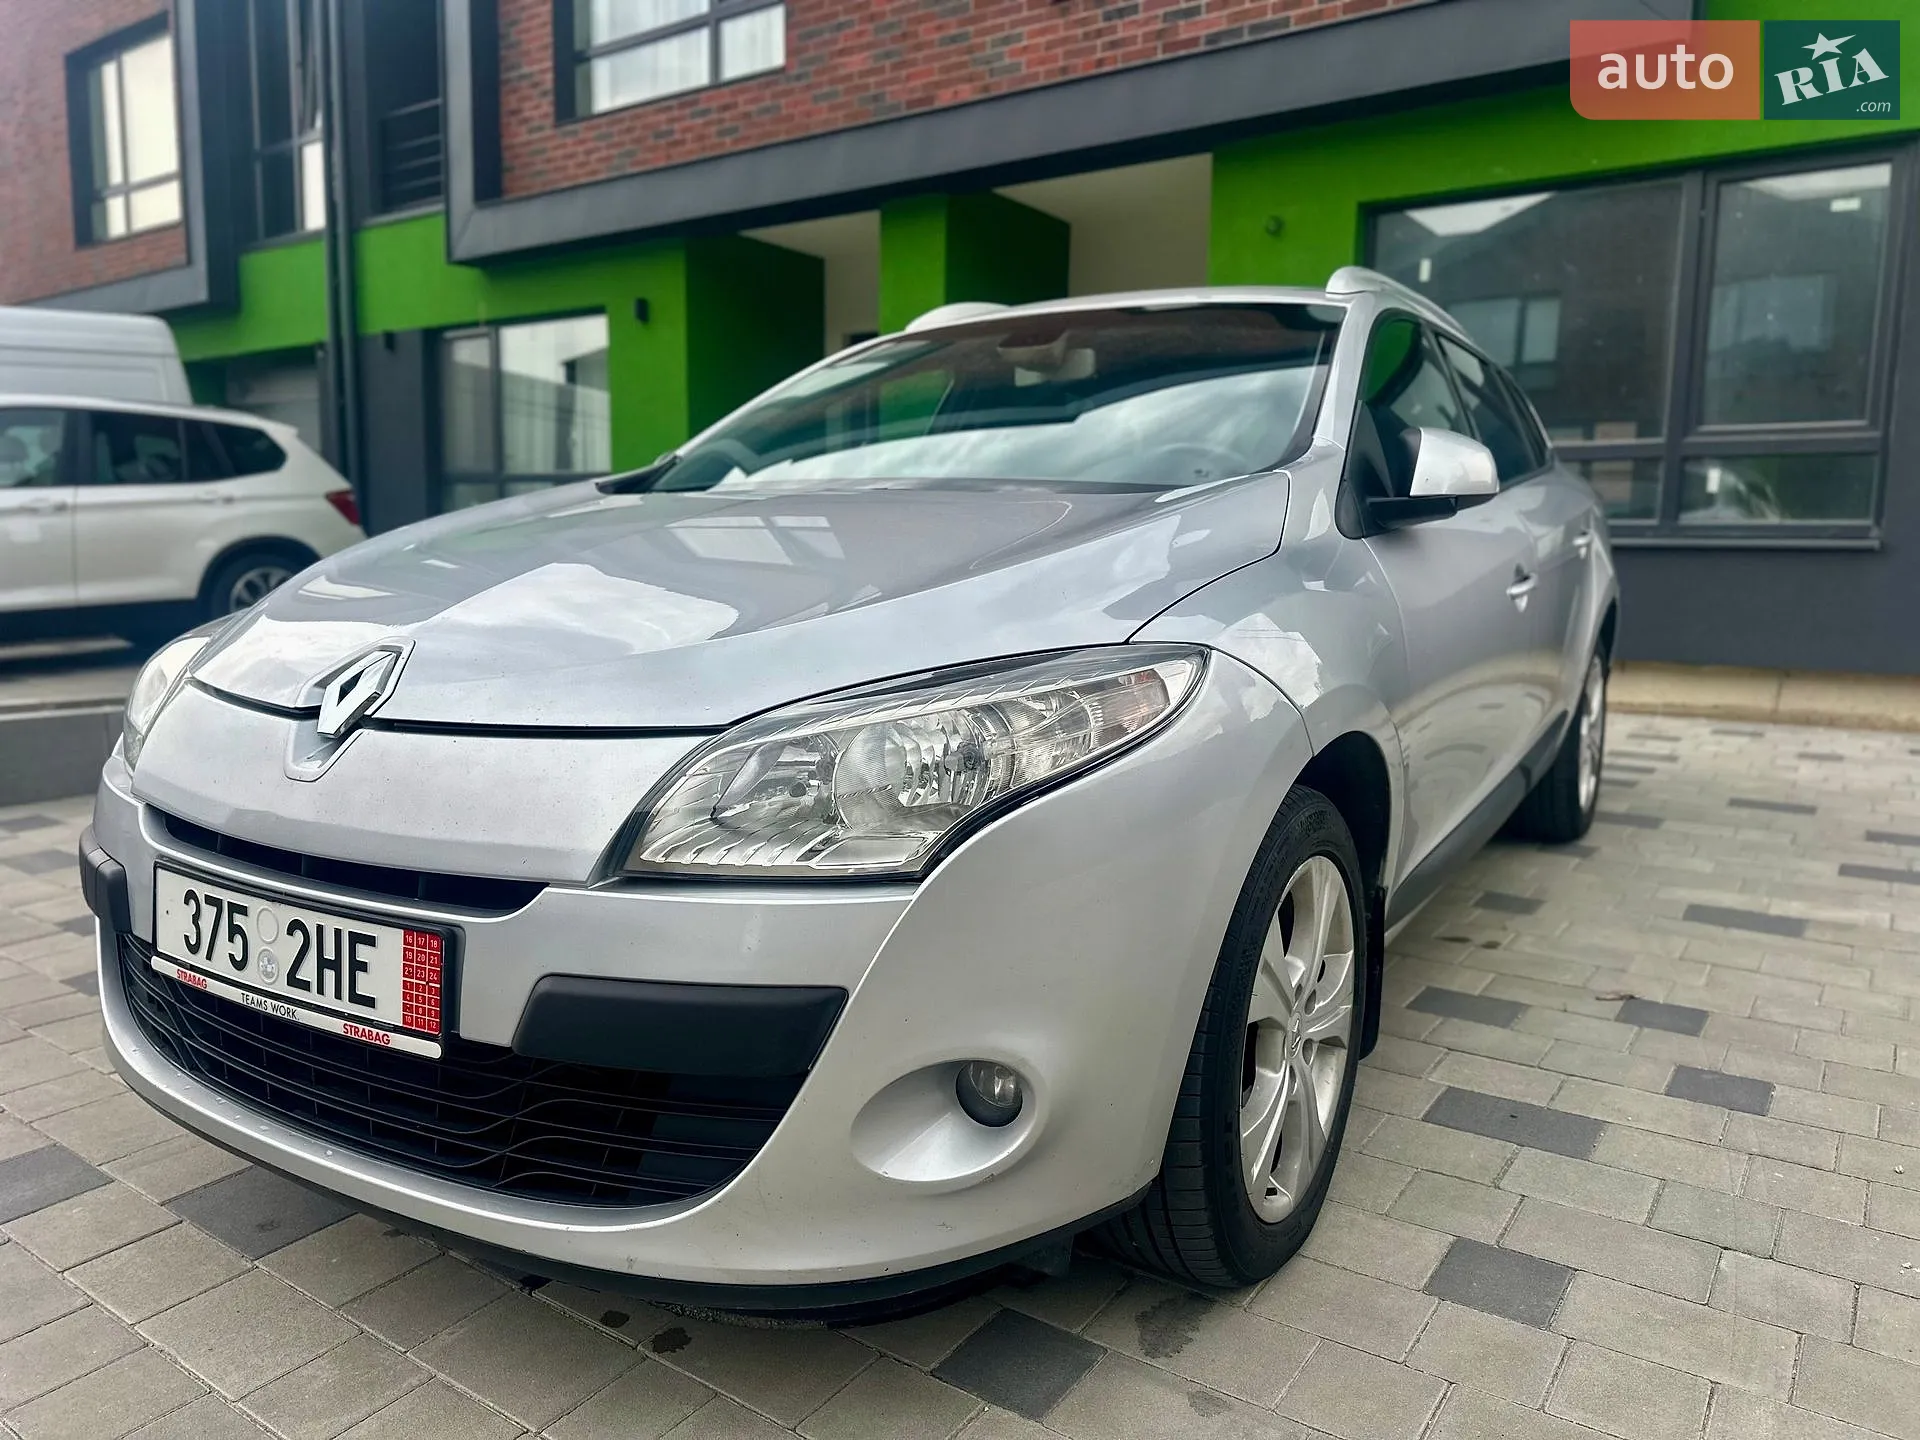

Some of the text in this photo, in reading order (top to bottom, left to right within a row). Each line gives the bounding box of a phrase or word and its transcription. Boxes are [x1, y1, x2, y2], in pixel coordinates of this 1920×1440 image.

[183, 888, 377, 1009] 375 2HE
[405, 934, 438, 949] 16 17 18
[405, 950, 438, 965] 19 20 21
[175, 968, 209, 990] STRABAG
[417, 969, 425, 978] 23
[429, 972, 438, 981] 24
[240, 991, 268, 1011] TEAMS
[405, 1015, 437, 1029] 10 11 12
[342, 1022, 391, 1046] STRABAG
